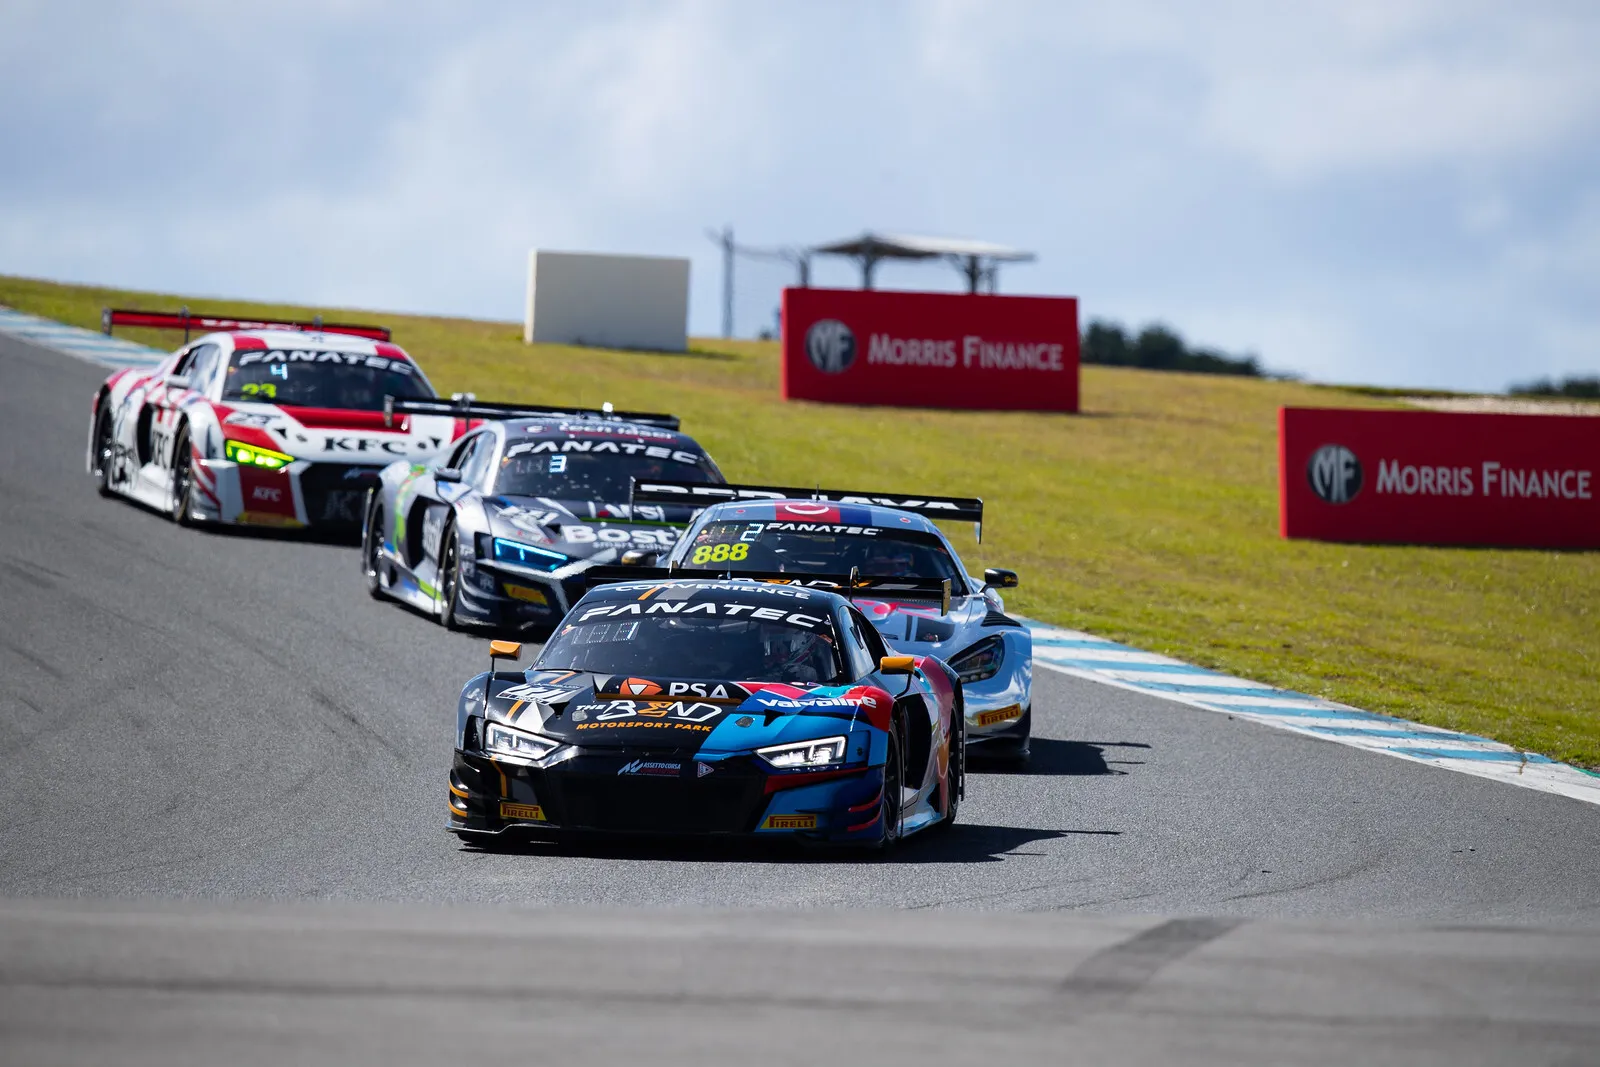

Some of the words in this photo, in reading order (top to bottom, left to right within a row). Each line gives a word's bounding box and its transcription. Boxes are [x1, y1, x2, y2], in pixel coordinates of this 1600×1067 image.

[867, 333, 956, 366] MORRIS
[963, 335, 1064, 371] FINANCE
[239, 350, 414, 375] FANATEC
[270, 364, 288, 380] 4
[323, 436, 408, 456] KFC
[506, 440, 701, 465] FANATEC
[549, 455, 568, 473] 3
[1376, 458, 1475, 496] MORRIS
[1481, 460, 1593, 500] FINANCE
[253, 487, 281, 502] KFC
[740, 523, 764, 541] 2
[765, 522, 881, 536] FANATEC
[692, 543, 749, 565] 888
[615, 582, 812, 601] CONVENIENCE
[578, 602, 823, 629] FANATEC
[669, 682, 729, 698] PSA
[576, 704, 607, 713] THE
[980, 704, 1019, 725] PIRELLI
[576, 721, 672, 731] MOTORSPORT
[674, 723, 713, 732] PARK
[502, 803, 539, 819] PIRELLI
[769, 815, 815, 828] PIRELLI
